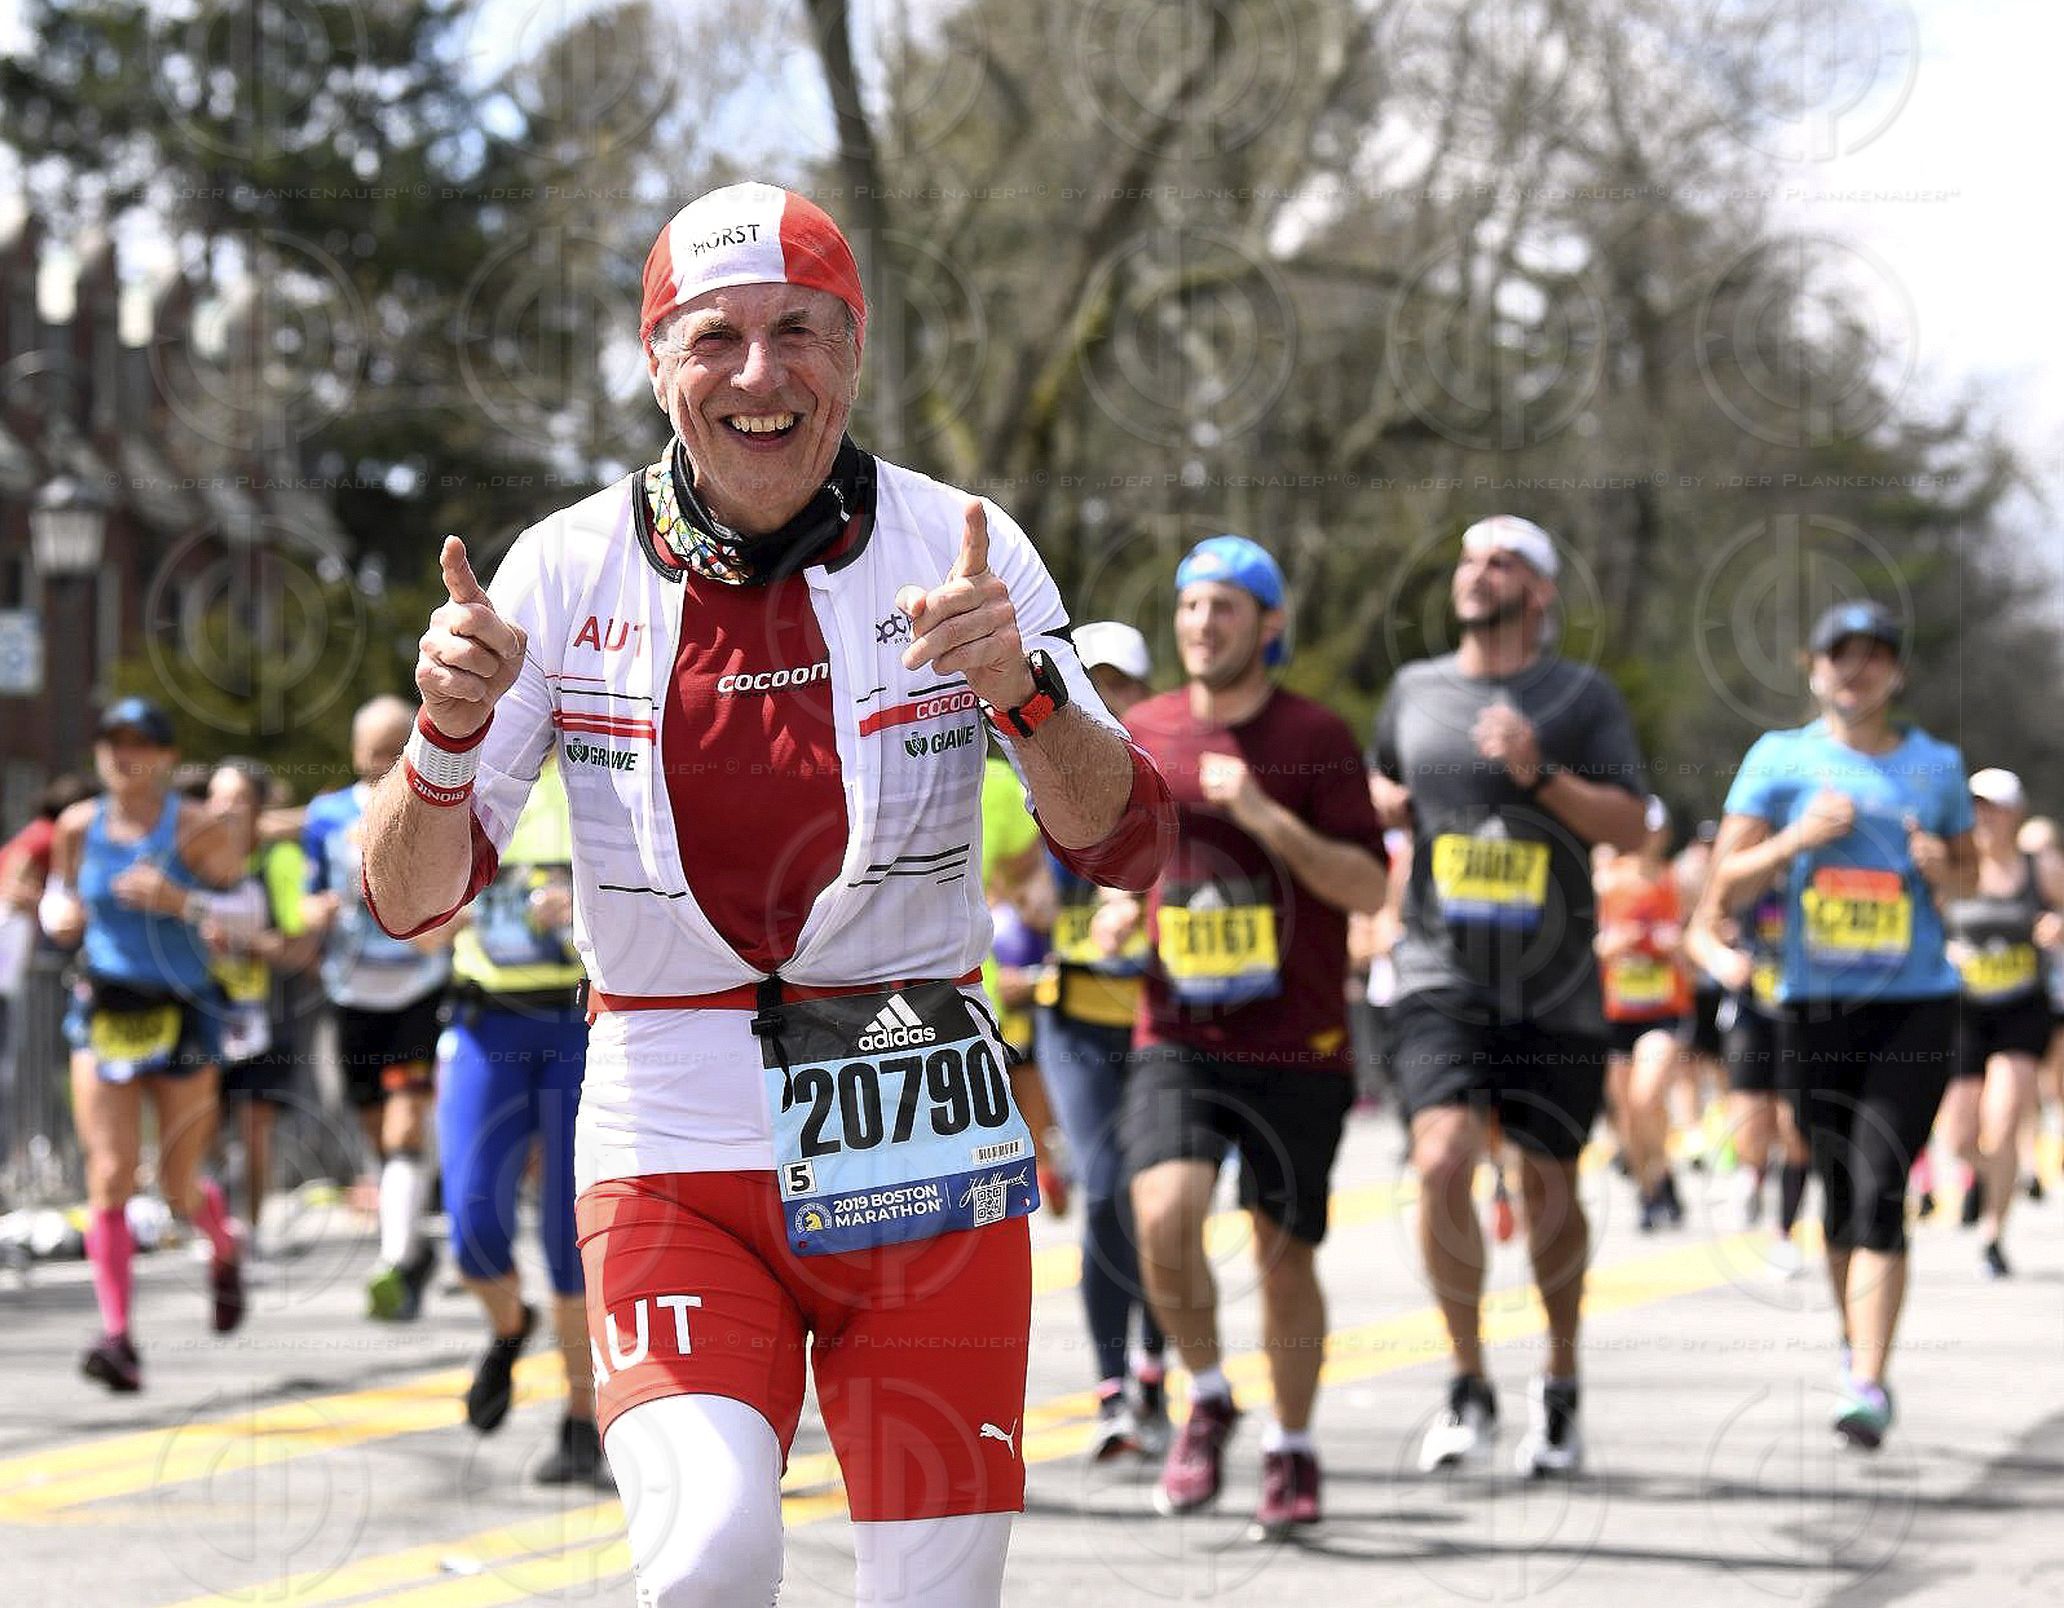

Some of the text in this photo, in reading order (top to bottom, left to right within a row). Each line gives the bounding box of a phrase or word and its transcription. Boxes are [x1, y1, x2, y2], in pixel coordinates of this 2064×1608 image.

[718, 662, 829, 692] cocoon
[858, 1026, 936, 1051] adidas
[793, 1040, 1010, 1158] 20790
[789, 1165, 811, 1191] 5
[833, 1183, 938, 1213] 2019 BOSTON
